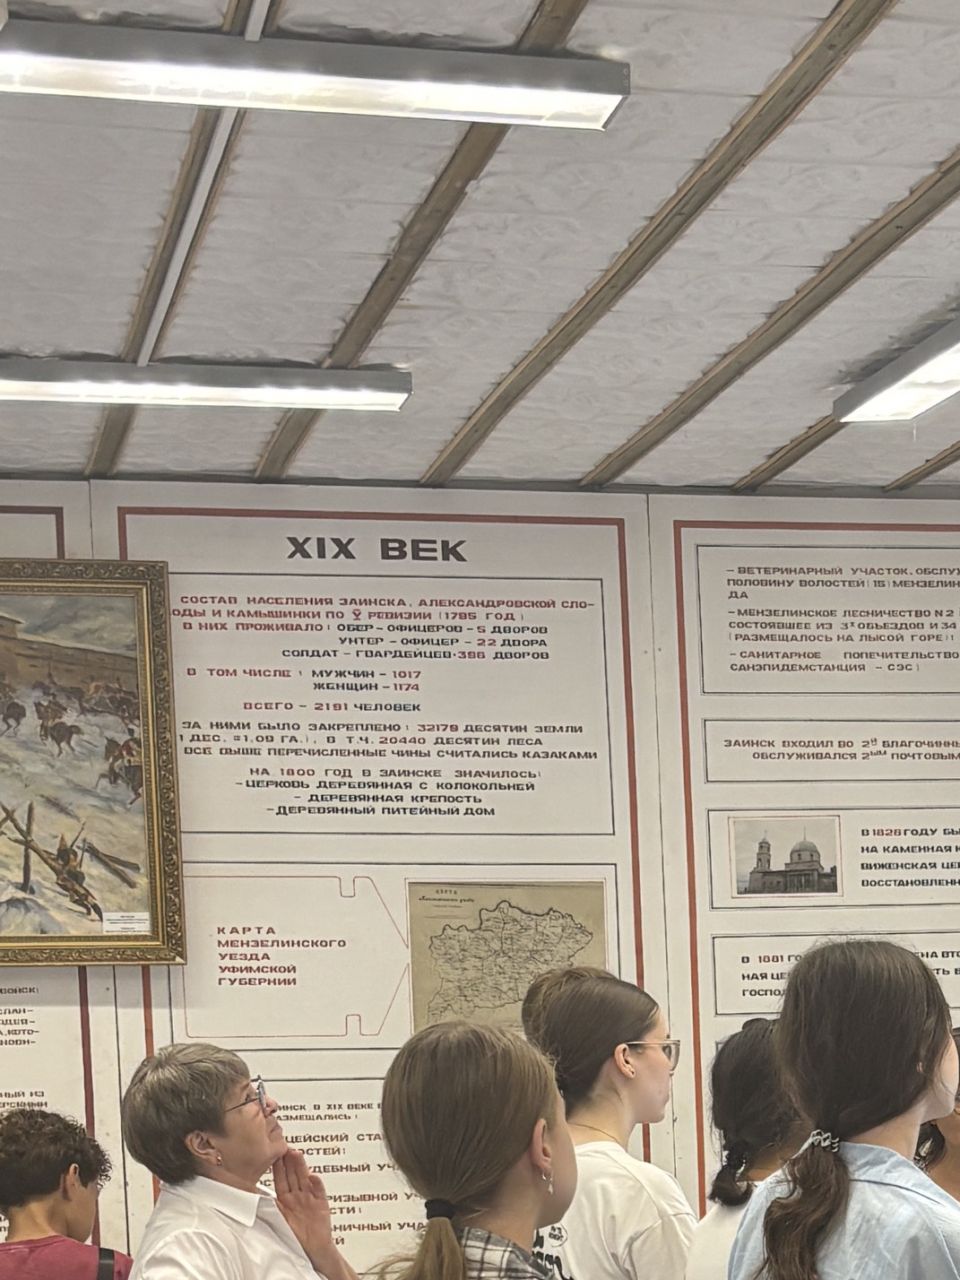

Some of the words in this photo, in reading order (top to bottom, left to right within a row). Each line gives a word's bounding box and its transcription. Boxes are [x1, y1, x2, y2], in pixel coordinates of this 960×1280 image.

[287, 537, 356, 559] XIX
[381, 538, 467, 562] ВЕК
[737, 566, 843, 575] ВЕТЕРИНАРНЫЙ
[727, 579, 794, 587] ПОЛОВИНУ
[799, 578, 864, 588] ВОЛОСТЕЙ
[728, 591, 748, 600] ДА
[181, 596, 237, 604] СОСТАВ
[247, 597, 333, 606] НАСЕЛЕНИЯ
[418, 598, 556, 609] АЛЕКСАНДРОВСКОЙ
[561, 600, 594, 609] СЛО-
[171, 609, 206, 618] ОДЫ
[227, 610, 321, 619] КАМЫШИНКИ
[326, 611, 344, 619] ПО
[368, 611, 432, 620] РЕВИЗИИ
[842, 609, 930, 618] ЛЕСНИЧЕСТВО
[199, 623, 228, 631] НИХ
[337, 624, 373, 632] ОБЕР
[387, 625, 463, 633] ОФИЦЕРОВ
[490, 626, 548, 634] ДВОРОВ
[729, 621, 811, 630] СОСТОЯВШЕЕ
[816, 622, 833, 630] ИЗ
[339, 637, 384, 645] УНТЕР
[401, 638, 459, 646] ОФИЦЕР
[500, 639, 547, 647] ДВОРА
[837, 634, 854, 642] НА
[859, 632, 904, 642] ЛЫСОЙ
[282, 650, 338, 658] СОЛДАТ
[493, 651, 549, 660] ДВОРОВ
[740, 651, 821, 659] САНИТАРНОЕ
[844, 651, 959, 660] ПОПЕЧИТЕЛЬСТВО
[730, 663, 866, 672] САНЭПИДЕМСТАНЦИЯ
[207, 669, 237, 677] ТОМ
[312, 670, 374, 678] МУЖЧИН
[392, 671, 421, 679] 1017
[313, 683, 378, 692] ЖЕНЩИН
[393, 683, 420, 692] 1174
[243, 702, 294, 710] ВСЕГО
[354, 703, 421, 712] ЧЕЛОВЕК
[182, 721, 201, 730] ЗА
[210, 722, 250, 730] НИМИ
[258, 722, 300, 731] БЫЛО
[463, 725, 527, 733] ДЕСЯТИН
[534, 726, 583, 734] ЗЕМЛИ
[379, 737, 426, 745] 20440
[433, 737, 500, 746] ДЕСЯТИН
[507, 738, 543, 746] ЛЕСА
[724, 739, 776, 748] ЗАИНСК
[782, 739, 834, 749] ВХОДИЛ
[838, 740, 854, 748] ВО
[184, 747, 212, 755] ВСЕ
[219, 747, 262, 756] ВЫШЕ
[267, 748, 387, 757] ПЕРЕЧИСЛЕННЫЕ
[391, 750, 431, 758] ЧИНЫ
[437, 750, 518, 759] СЧИТАЛИСЬ
[522, 750, 598, 759] КАЗАКАМИ
[752, 751, 857, 761] ОБСЛУЖИВАЛСЯ
[250, 768, 270, 776] НА
[325, 769, 353, 778] ГОД
[316, 780, 412, 790] ДЕРЕВЯННАЯ
[437, 782, 535, 791] КОЛОКОЛЬНЕЙ
[308, 794, 404, 803] ДЕРЕВЯННАЯ
[410, 795, 482, 803] КРЕПОСТЬ
[382, 805, 460, 815] ПИТЕЙНЫЙ
[463, 807, 495, 816] ДОМ
[903, 828, 937, 837] ГОДУ
[861, 846, 879, 854] НА
[861, 862, 937, 870] ВИЖЕНСКАЯ
[217, 925, 276, 936] КАРТА
[217, 938, 347, 949] МЕНЗЕЛИНСКОГО
[218, 952, 271, 962] УЕЗДА
[218, 963, 297, 975] УФИМСКОЙ
[218, 976, 297, 986] ГУБЕРНИИ
[742, 971, 768, 981] НАЯ
